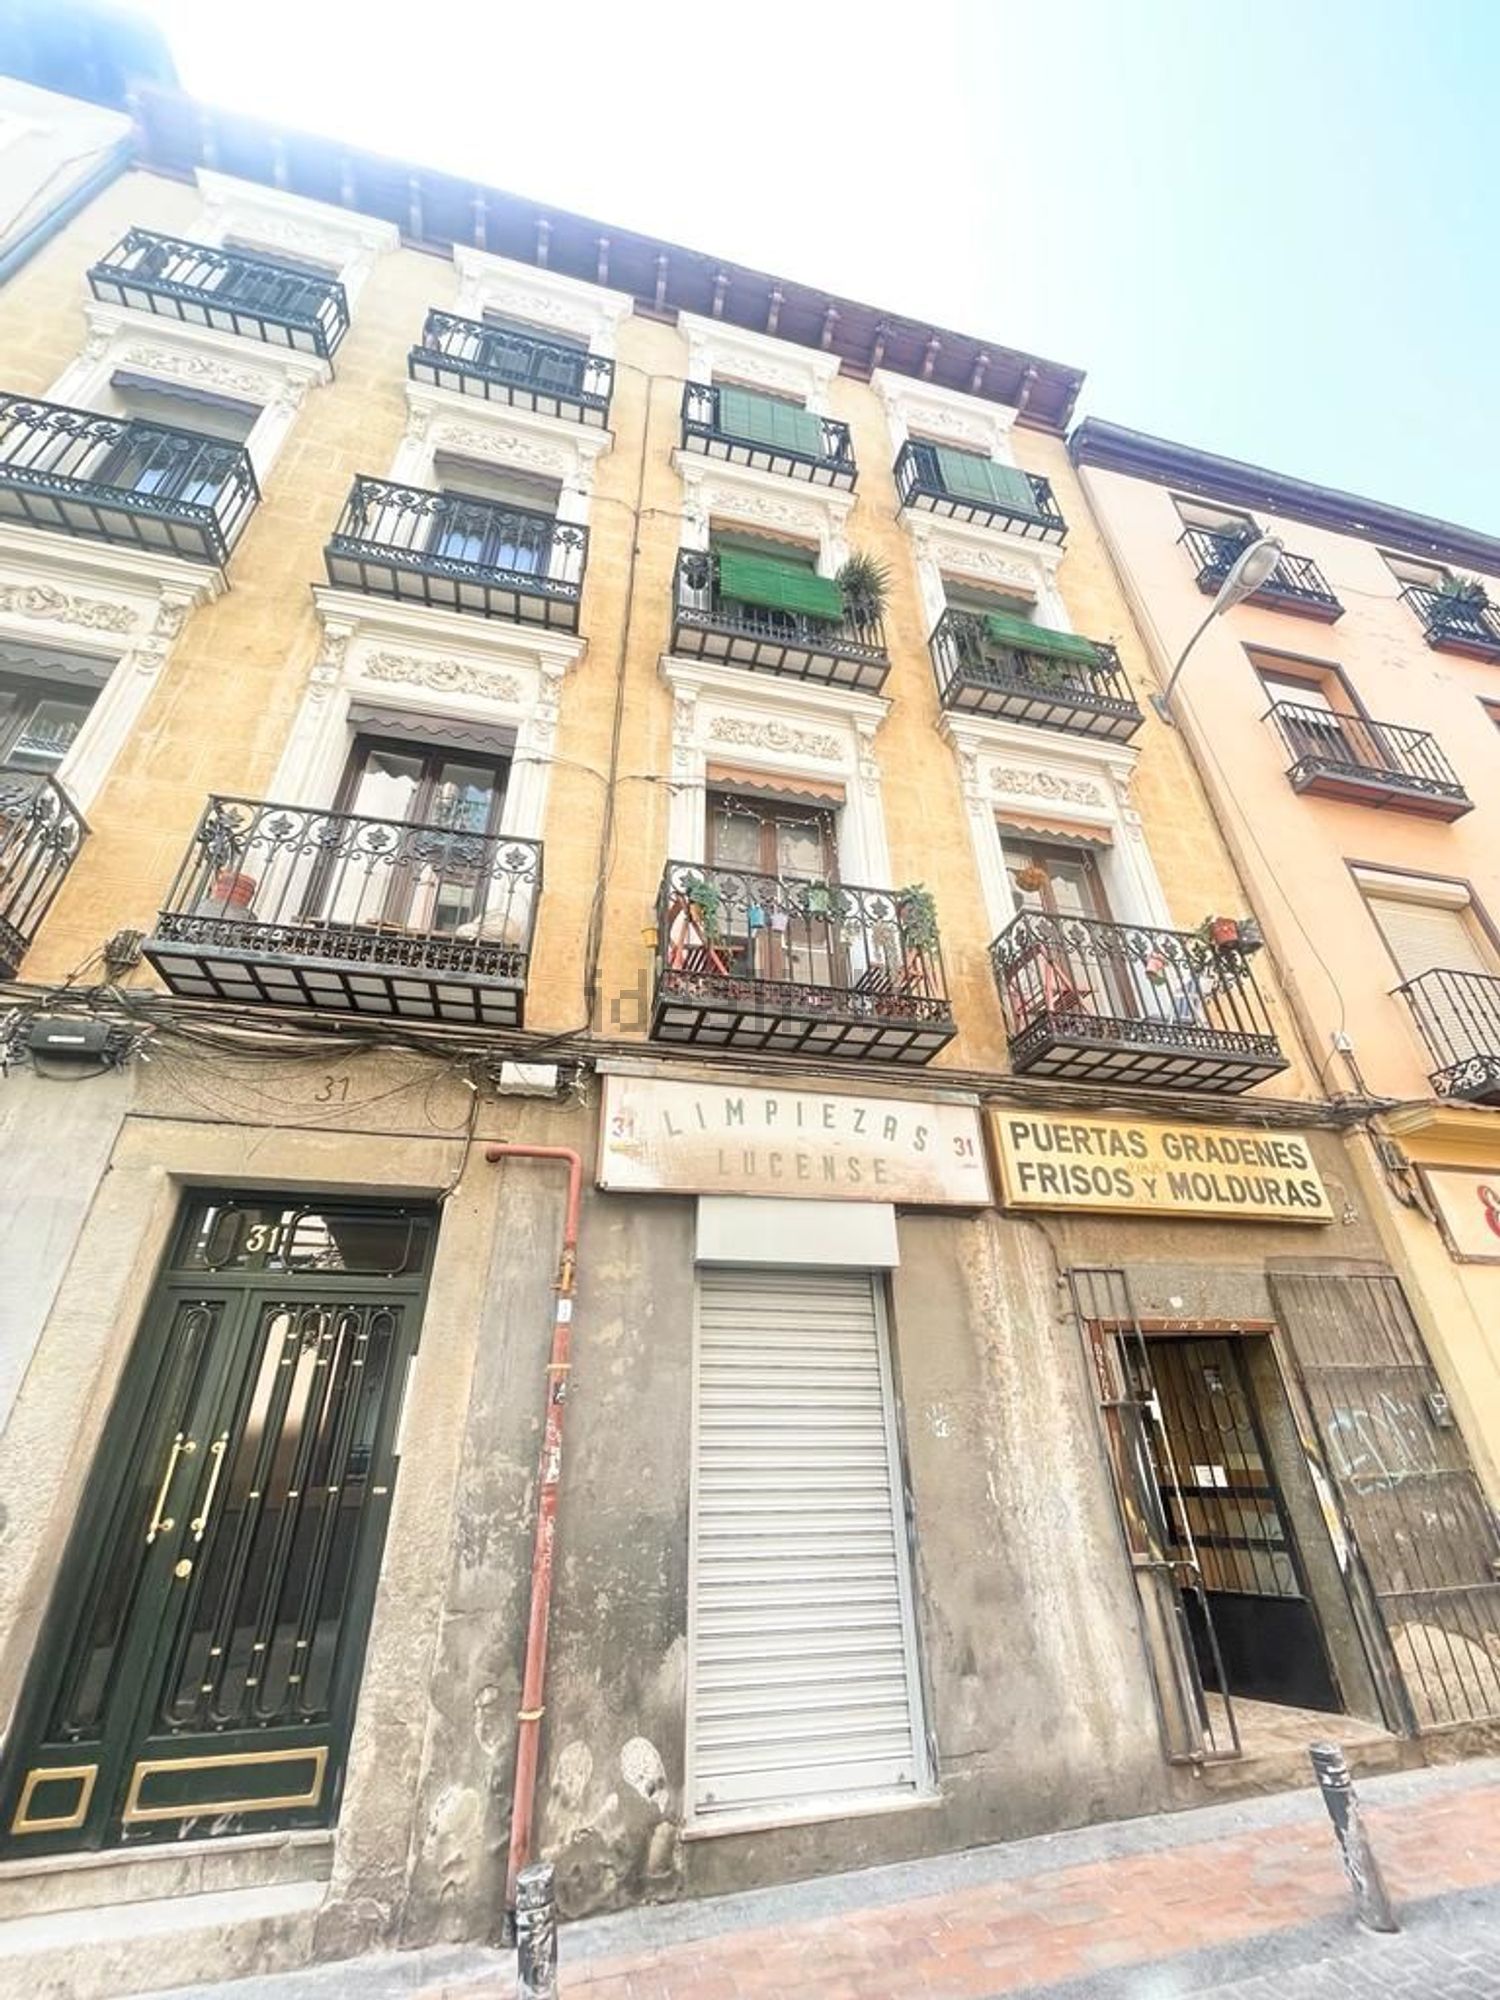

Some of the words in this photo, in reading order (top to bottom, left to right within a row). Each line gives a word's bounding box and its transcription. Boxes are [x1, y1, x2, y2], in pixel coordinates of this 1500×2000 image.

[314, 1075, 350, 1102] 31
[663, 1098, 928, 1152] LIMPIEZAS
[952, 1136, 975, 1158] 31
[1009, 1121, 1149, 1159] PUERTAS
[1161, 1132, 1308, 1170] GRADENES
[718, 1149, 888, 1185] LUCENSE
[1016, 1161, 1135, 1199] FRISOS
[1140, 1176, 1157, 1199] Y
[1165, 1171, 1322, 1208] MOLDURAS
[246, 1224, 281, 1254] 31
